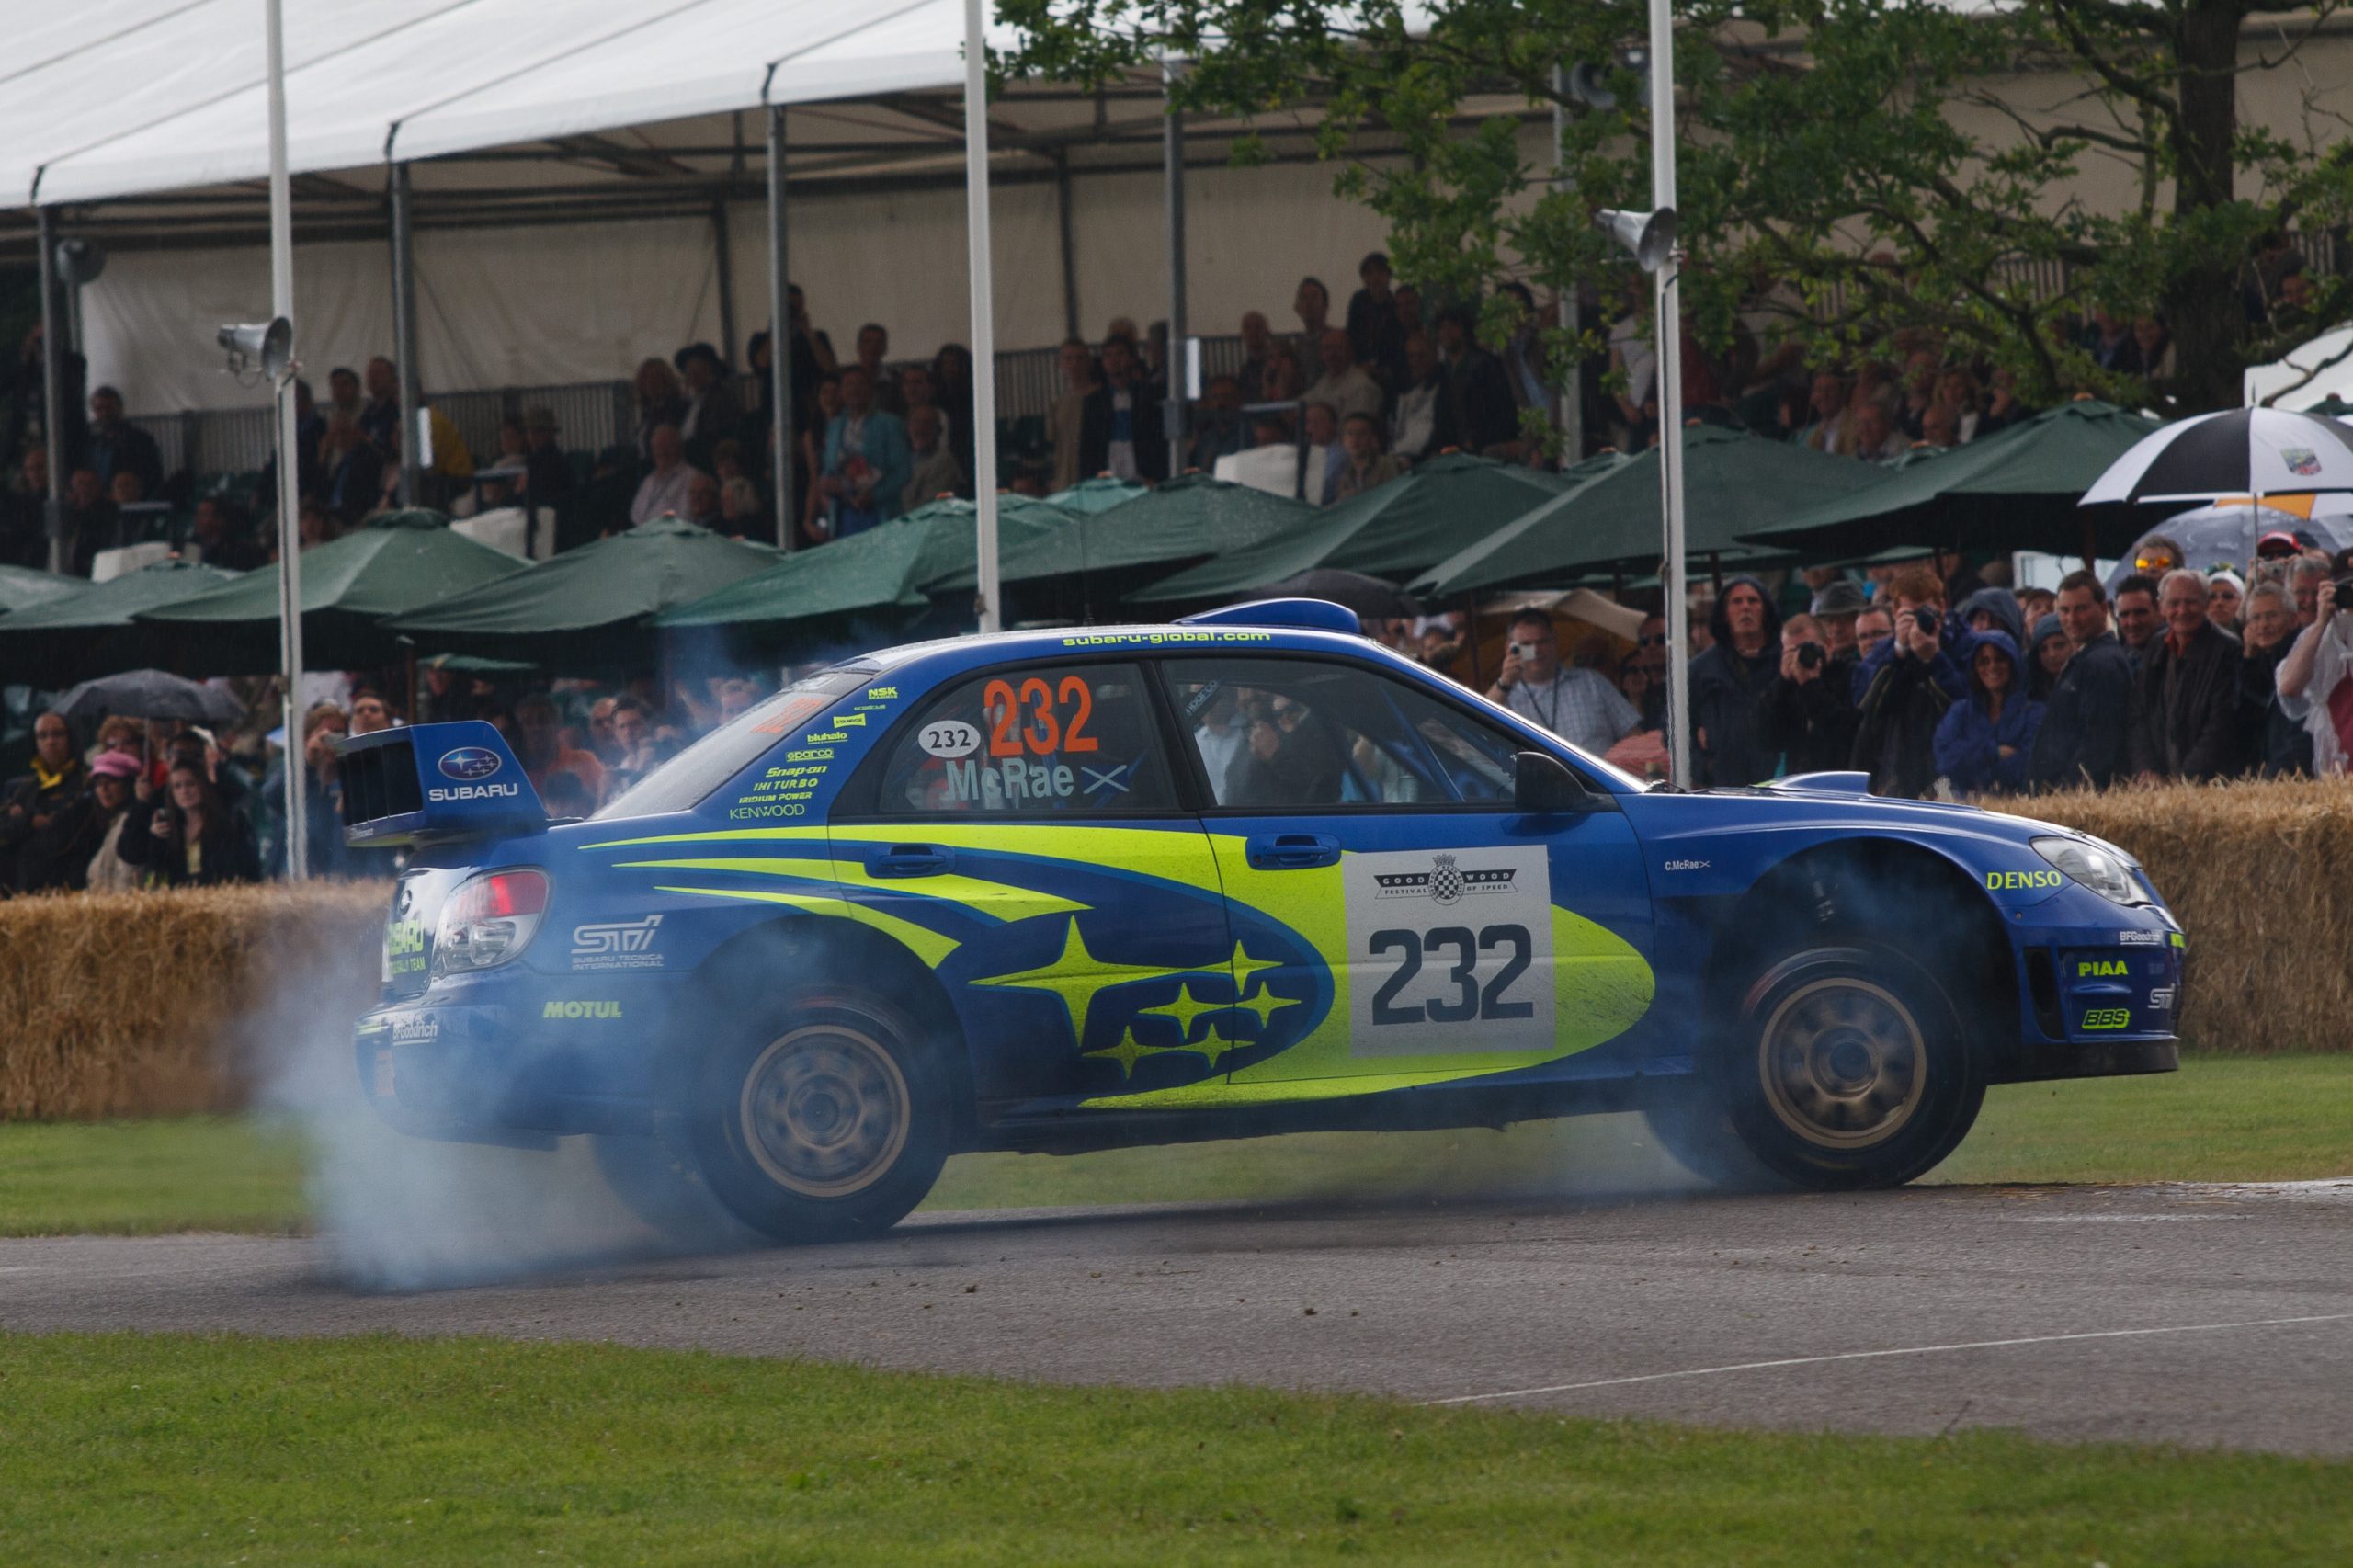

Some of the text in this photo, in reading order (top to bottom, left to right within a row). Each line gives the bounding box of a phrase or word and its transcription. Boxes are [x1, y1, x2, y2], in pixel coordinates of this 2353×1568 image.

[1063, 631, 1271, 646] subaru-global.com
[868, 687, 898, 697] NSK
[983, 676, 1098, 756] 232
[807, 732, 847, 742] bluhalo
[928, 729, 972, 749] 232
[786, 748, 833, 760] sparco
[765, 766, 828, 778] Snap-on
[946, 757, 1074, 801] McRae
[428, 782, 518, 802] SUBARU
[753, 778, 819, 791] IHI TURBO
[739, 791, 813, 804] IRIDIUM POWER
[729, 803, 805, 821] KENWOOD
[1986, 870, 2062, 890] DENSO
[572, 960, 665, 971] INTERNATIONAL
[2078, 960, 2129, 977] PIAA
[1369, 923, 1534, 1026] 232
[541, 1000, 622, 1018] MOTUL
[2082, 1009, 2130, 1028] BBS
